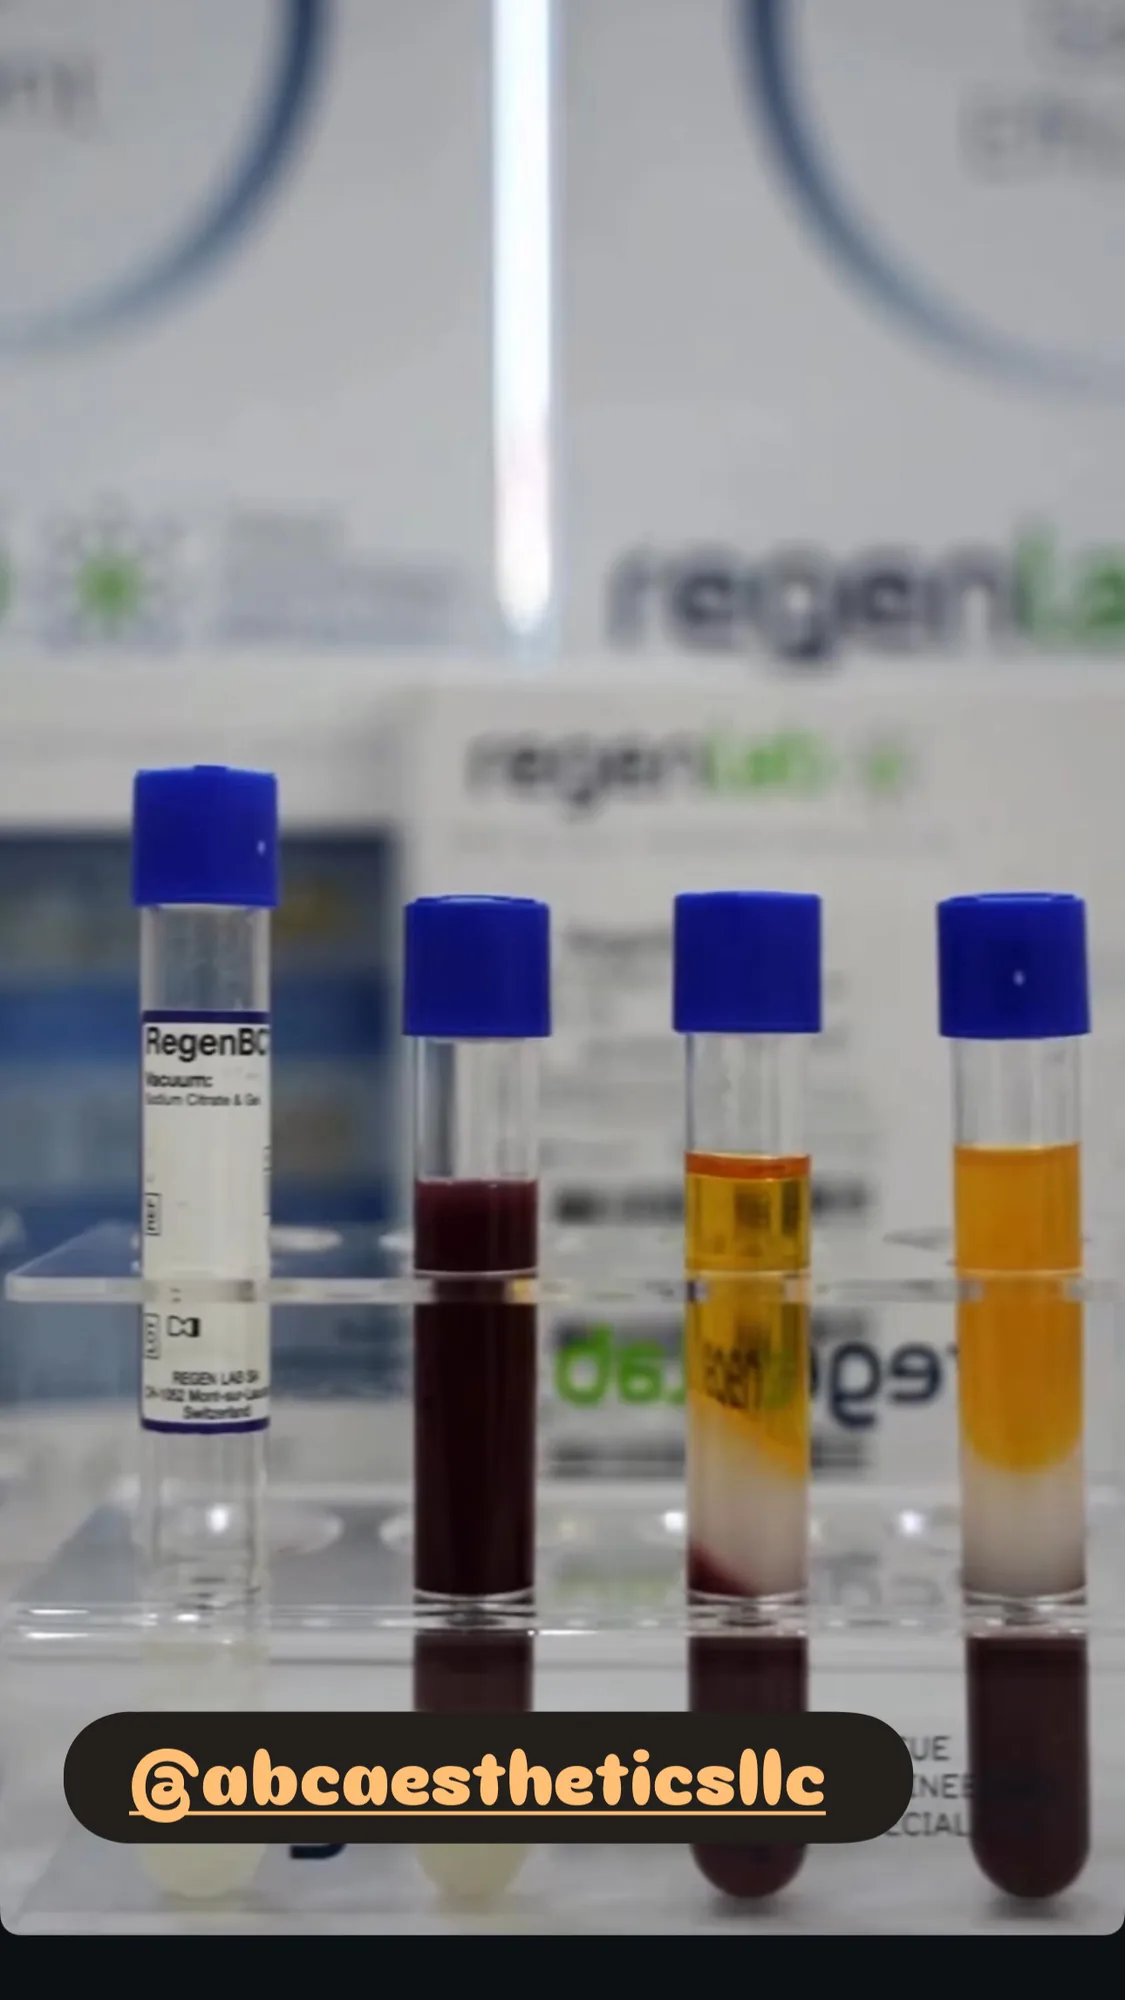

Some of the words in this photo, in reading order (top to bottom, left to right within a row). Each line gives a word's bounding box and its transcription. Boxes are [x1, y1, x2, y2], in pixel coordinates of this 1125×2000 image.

[186, 1092, 230, 1106] Citrate
[233, 1093, 242, 1106] &
[171, 1370, 217, 1385] REGEN
[220, 1370, 244, 1386] LAB
[901, 1735, 951, 1761] UE
